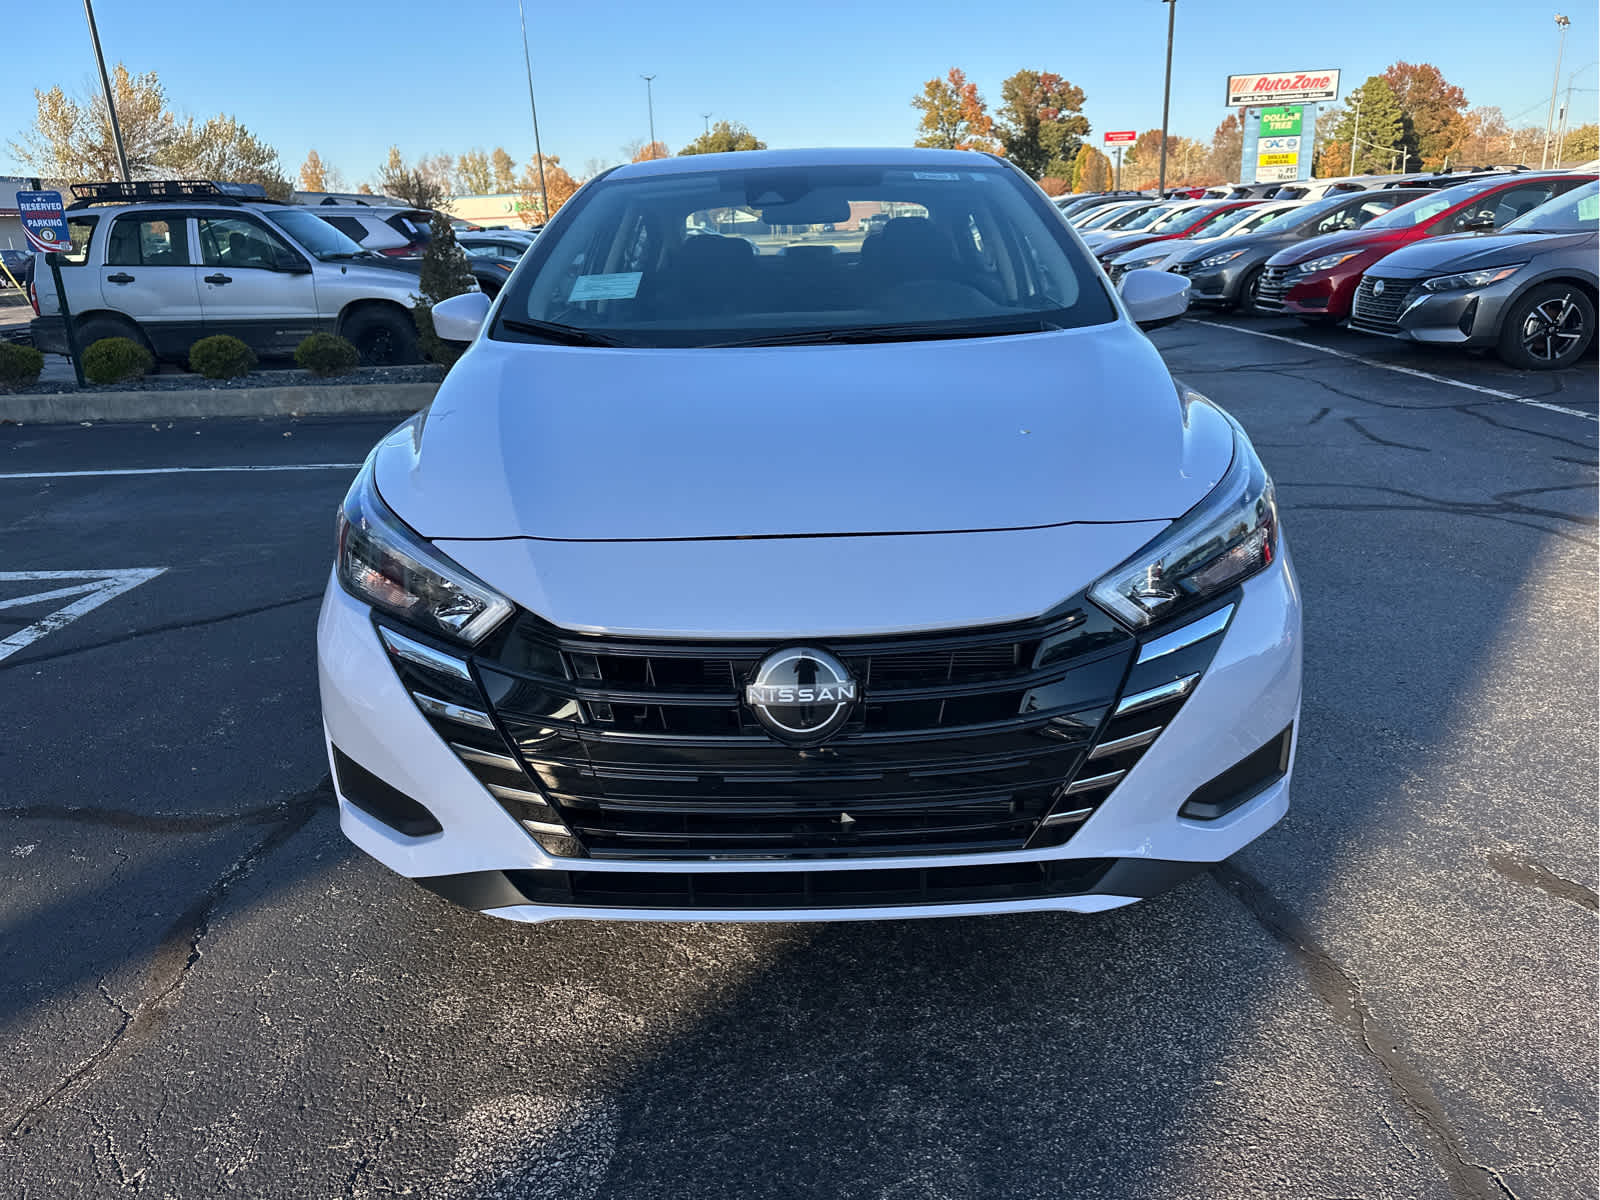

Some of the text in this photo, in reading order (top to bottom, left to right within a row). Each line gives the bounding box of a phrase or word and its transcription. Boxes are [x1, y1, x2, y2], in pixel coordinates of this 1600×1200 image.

[1253, 75, 1330, 92] AutoZone
[1263, 112, 1301, 122] DOLLAR
[1270, 121, 1293, 130] TREE
[21, 203, 62, 211] RESERVED
[27, 219, 63, 227] PARKING
[748, 685, 855, 704] NISSAN
